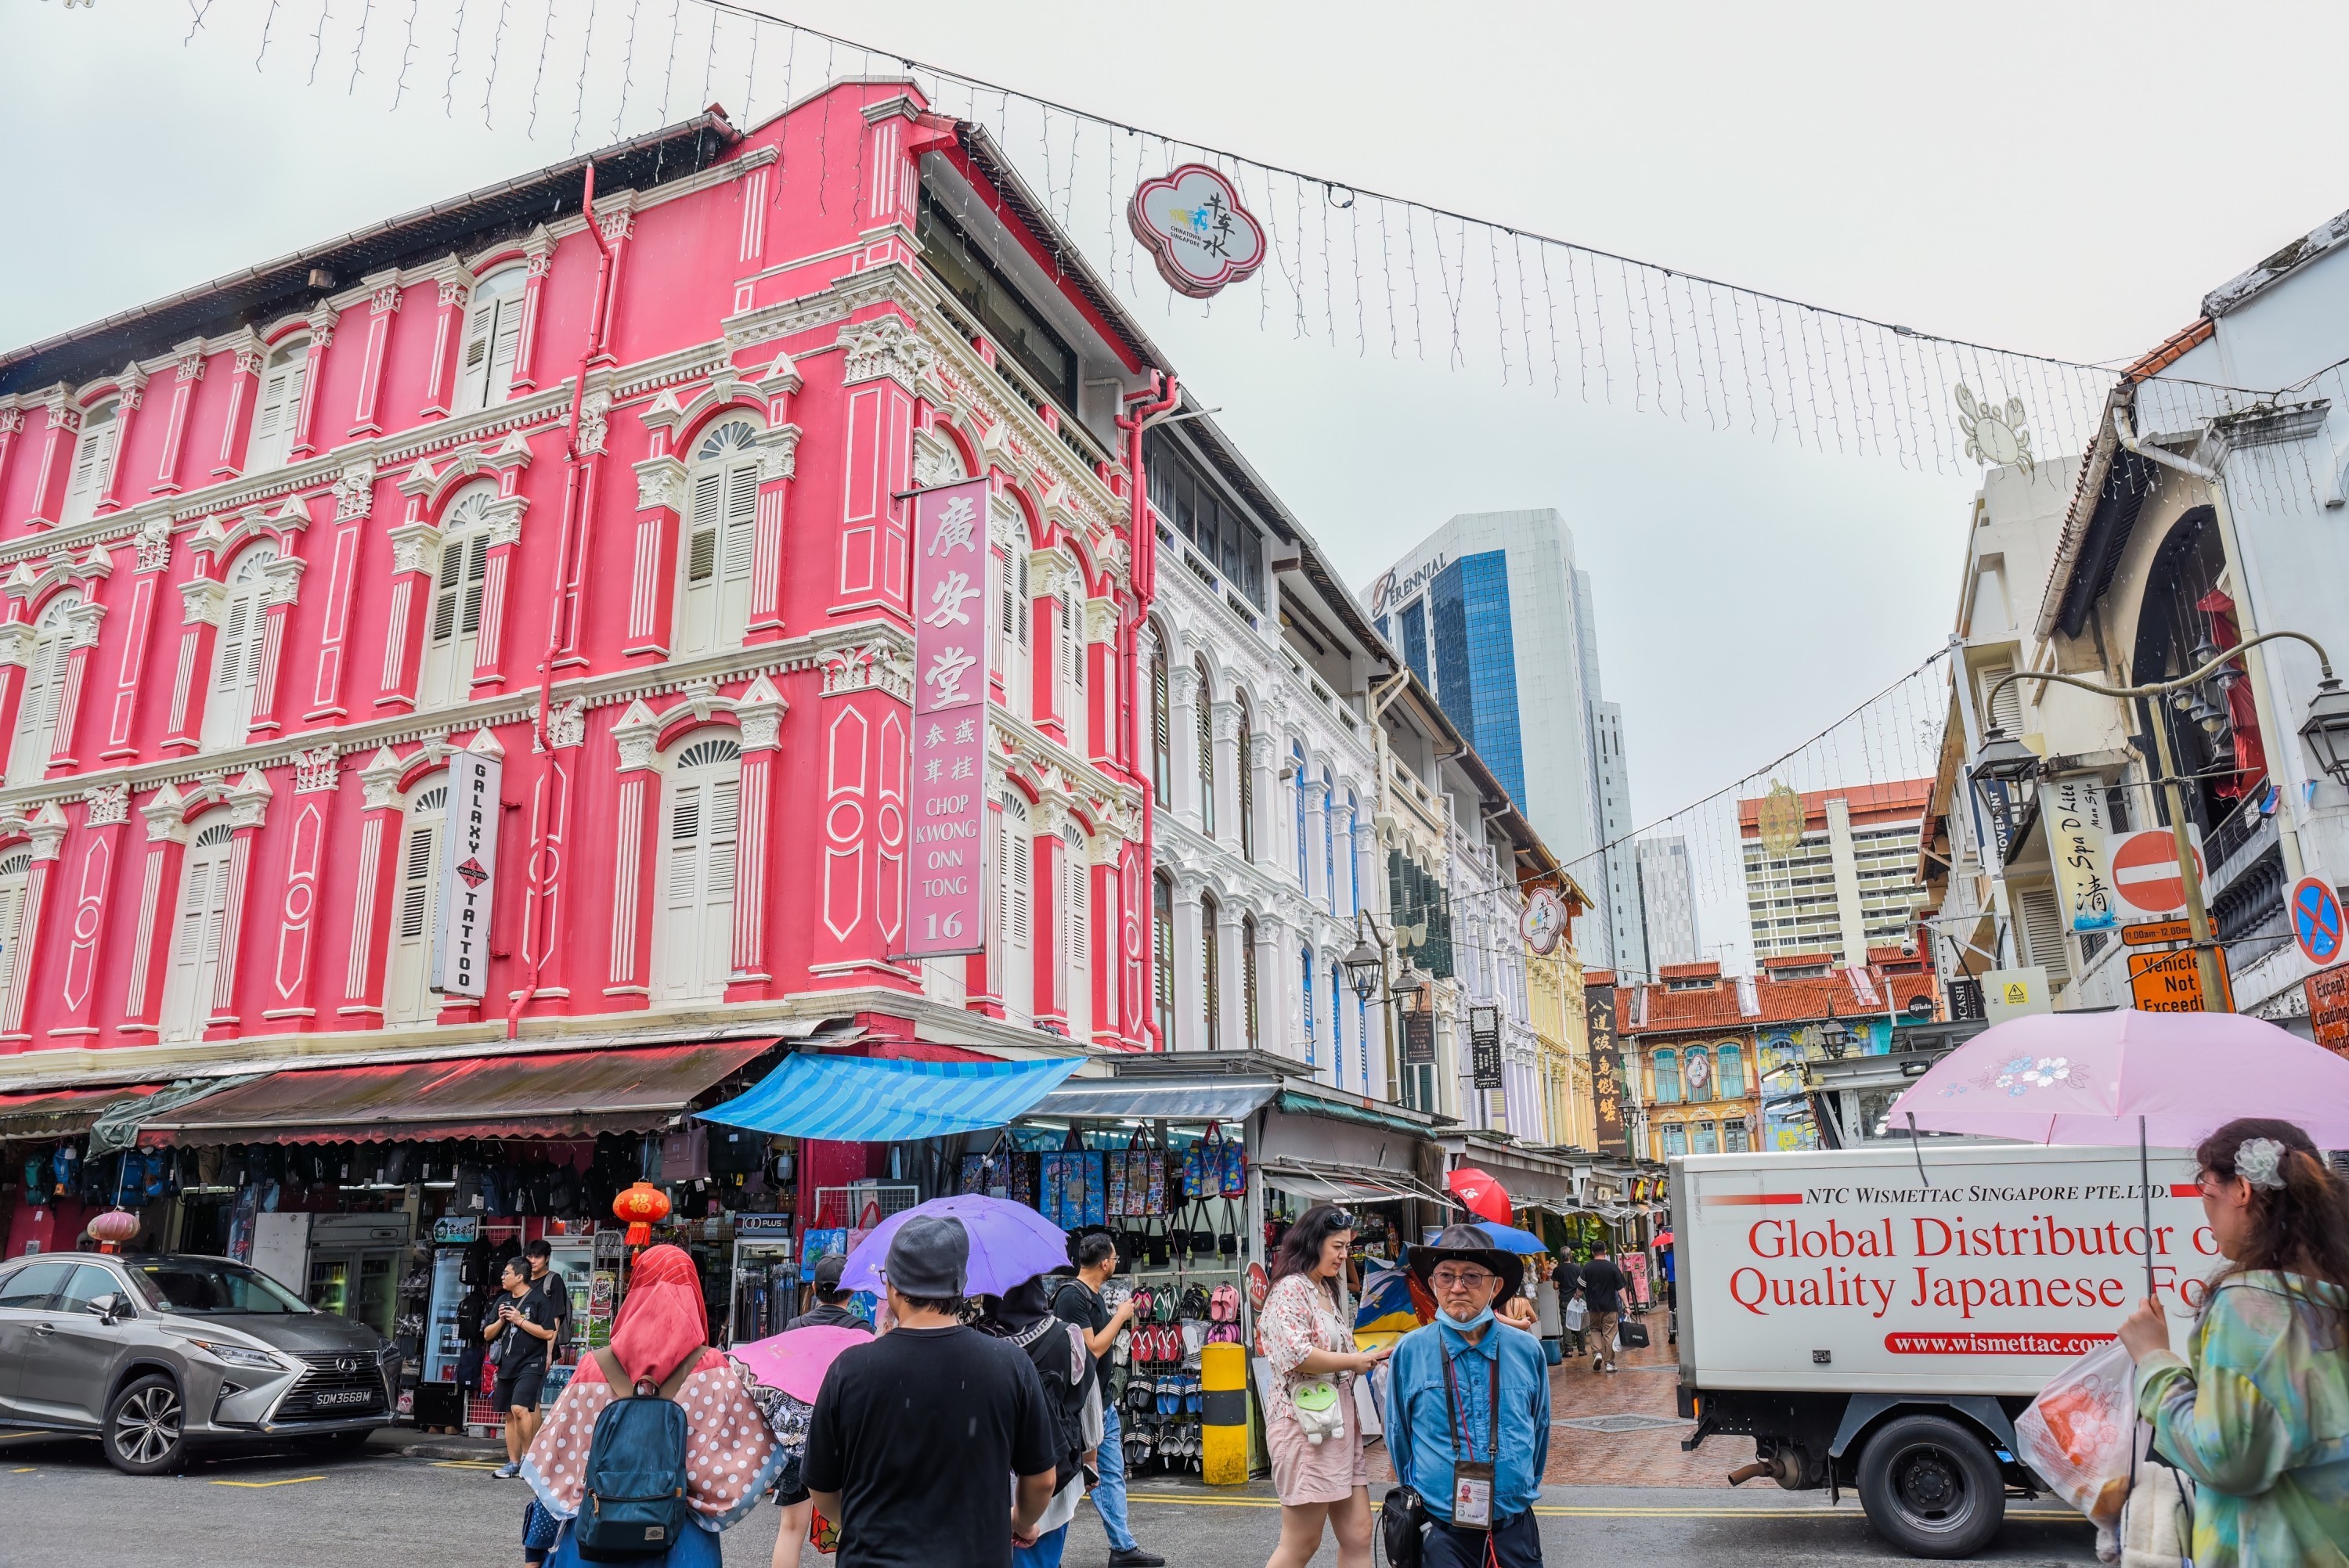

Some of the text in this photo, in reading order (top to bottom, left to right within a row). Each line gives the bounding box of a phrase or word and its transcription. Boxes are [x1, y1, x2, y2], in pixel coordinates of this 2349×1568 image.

[1171, 225, 1201, 241] CHINATOWN
[1203, 192, 1236, 258] 牛车水
[1170, 232, 1200, 247] SINGAPORE
[1372, 551, 1447, 618] PERENNIAL
[923, 496, 981, 711] 廣安堂
[468, 763, 486, 855] GALAXY
[926, 794, 969, 816] CHOP
[1990, 791, 2008, 857] MOVEMNT
[2058, 784, 2095, 871] Spa D Lite
[2090, 807, 2103, 830] Man
[915, 819, 977, 845] KWONG
[927, 848, 963, 871] ONN
[922, 875, 968, 899] TONG
[2077, 874, 2109, 912] 清
[923, 909, 965, 942] 16
[458, 891, 478, 987] TATTOO
[2143, 953, 2198, 974] Vehicle
[2164, 974, 2196, 993] Not
[2316, 974, 2346, 998] Except
[2143, 994, 2205, 1012] Exceedi
[628, 1193, 652, 1214] 福
[1806, 1188, 1849, 1205] NTC
[742, 1217, 761, 1230] 100
[1748, 1214, 2220, 1258] Global Distributor o
[1730, 1266, 1896, 1318] Quality
[1911, 1267, 2126, 1318] Japanese
[1894, 1333, 2116, 1353] www.wismettac.com
[316, 1391, 370, 1405] SDM3668M
